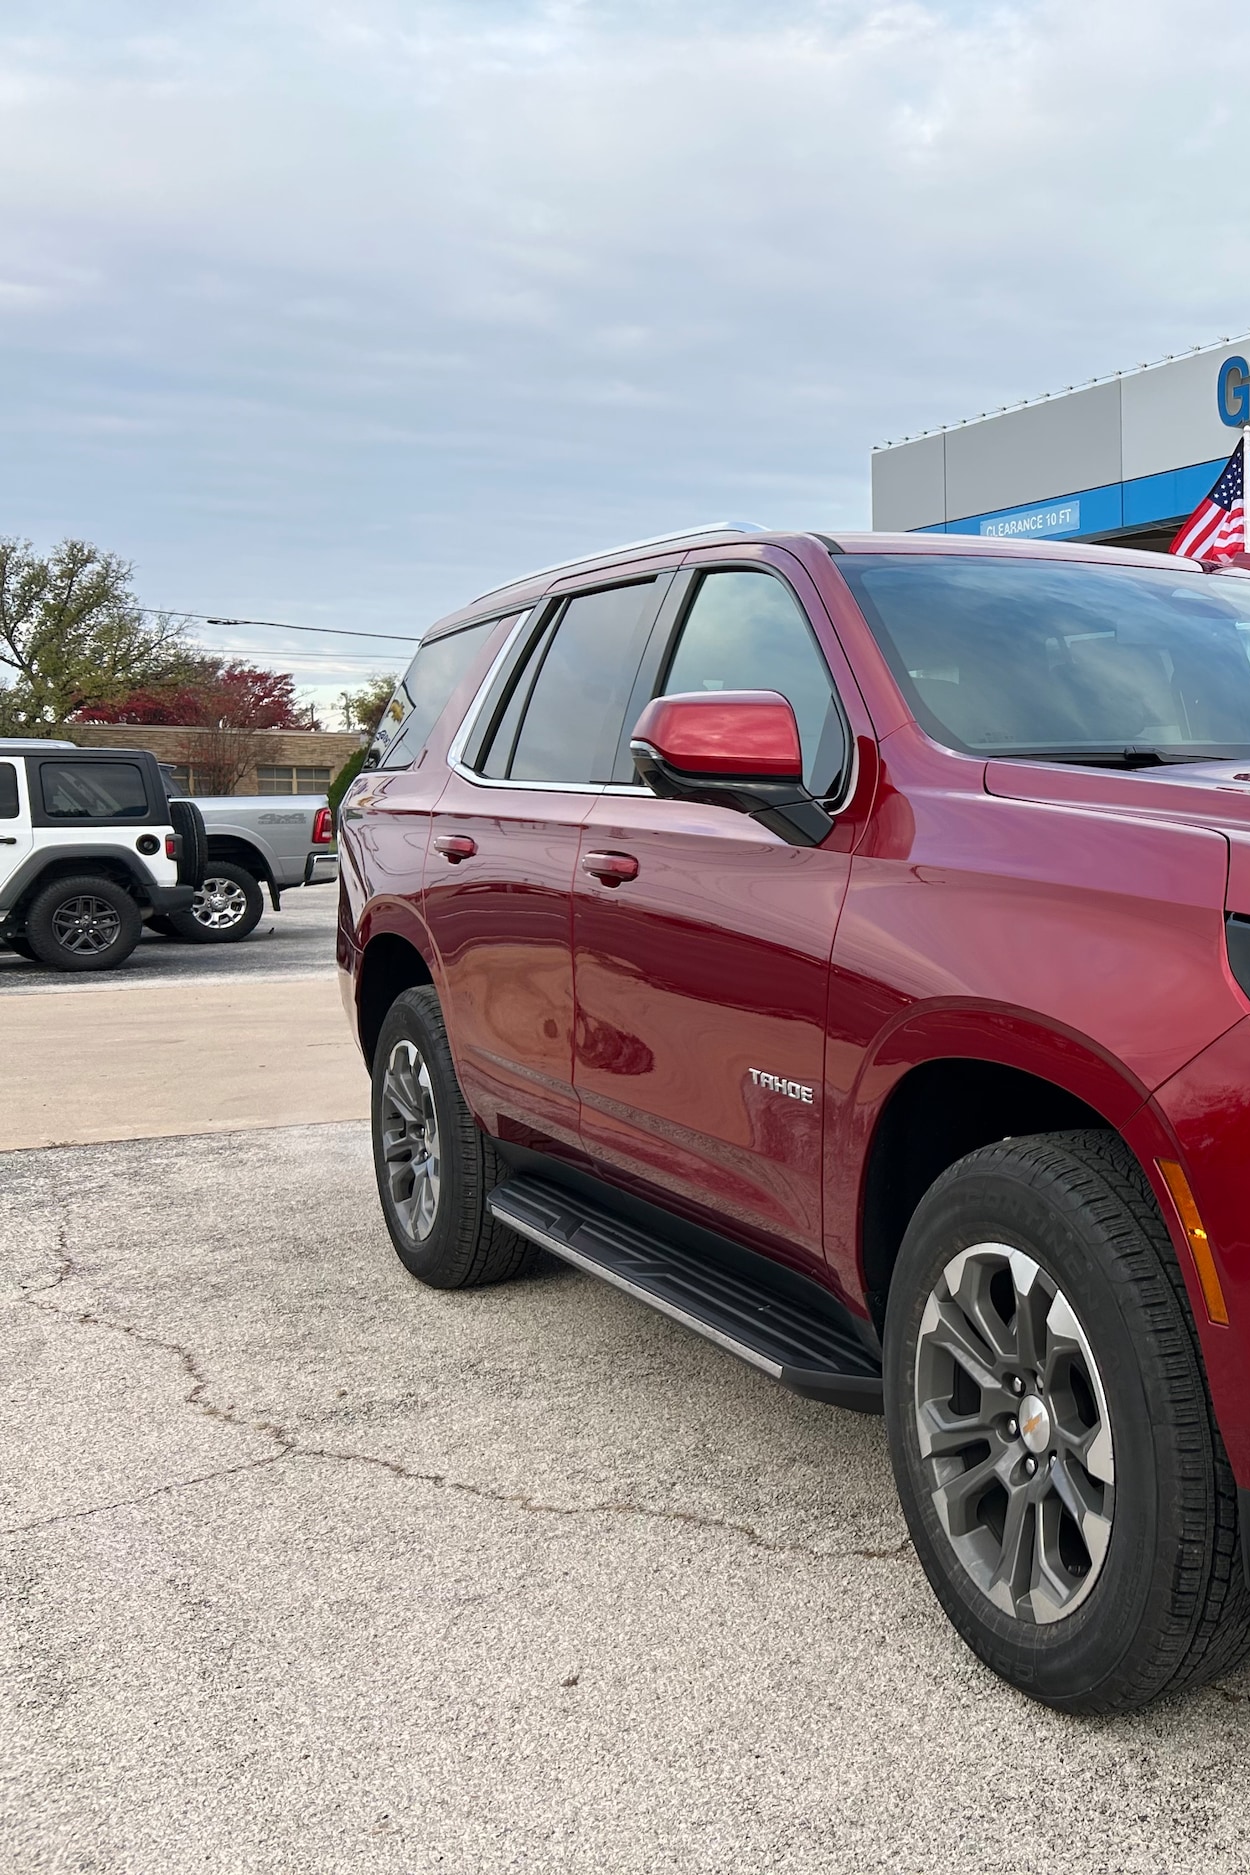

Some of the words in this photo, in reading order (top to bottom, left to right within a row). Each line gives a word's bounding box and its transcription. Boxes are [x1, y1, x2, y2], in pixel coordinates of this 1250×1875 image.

[986, 515, 1043, 537] CLEARANCE
[1046, 513, 1057, 527] 10
[1059, 508, 1072, 524] FT
[748, 1067, 814, 1104] TAHOE
